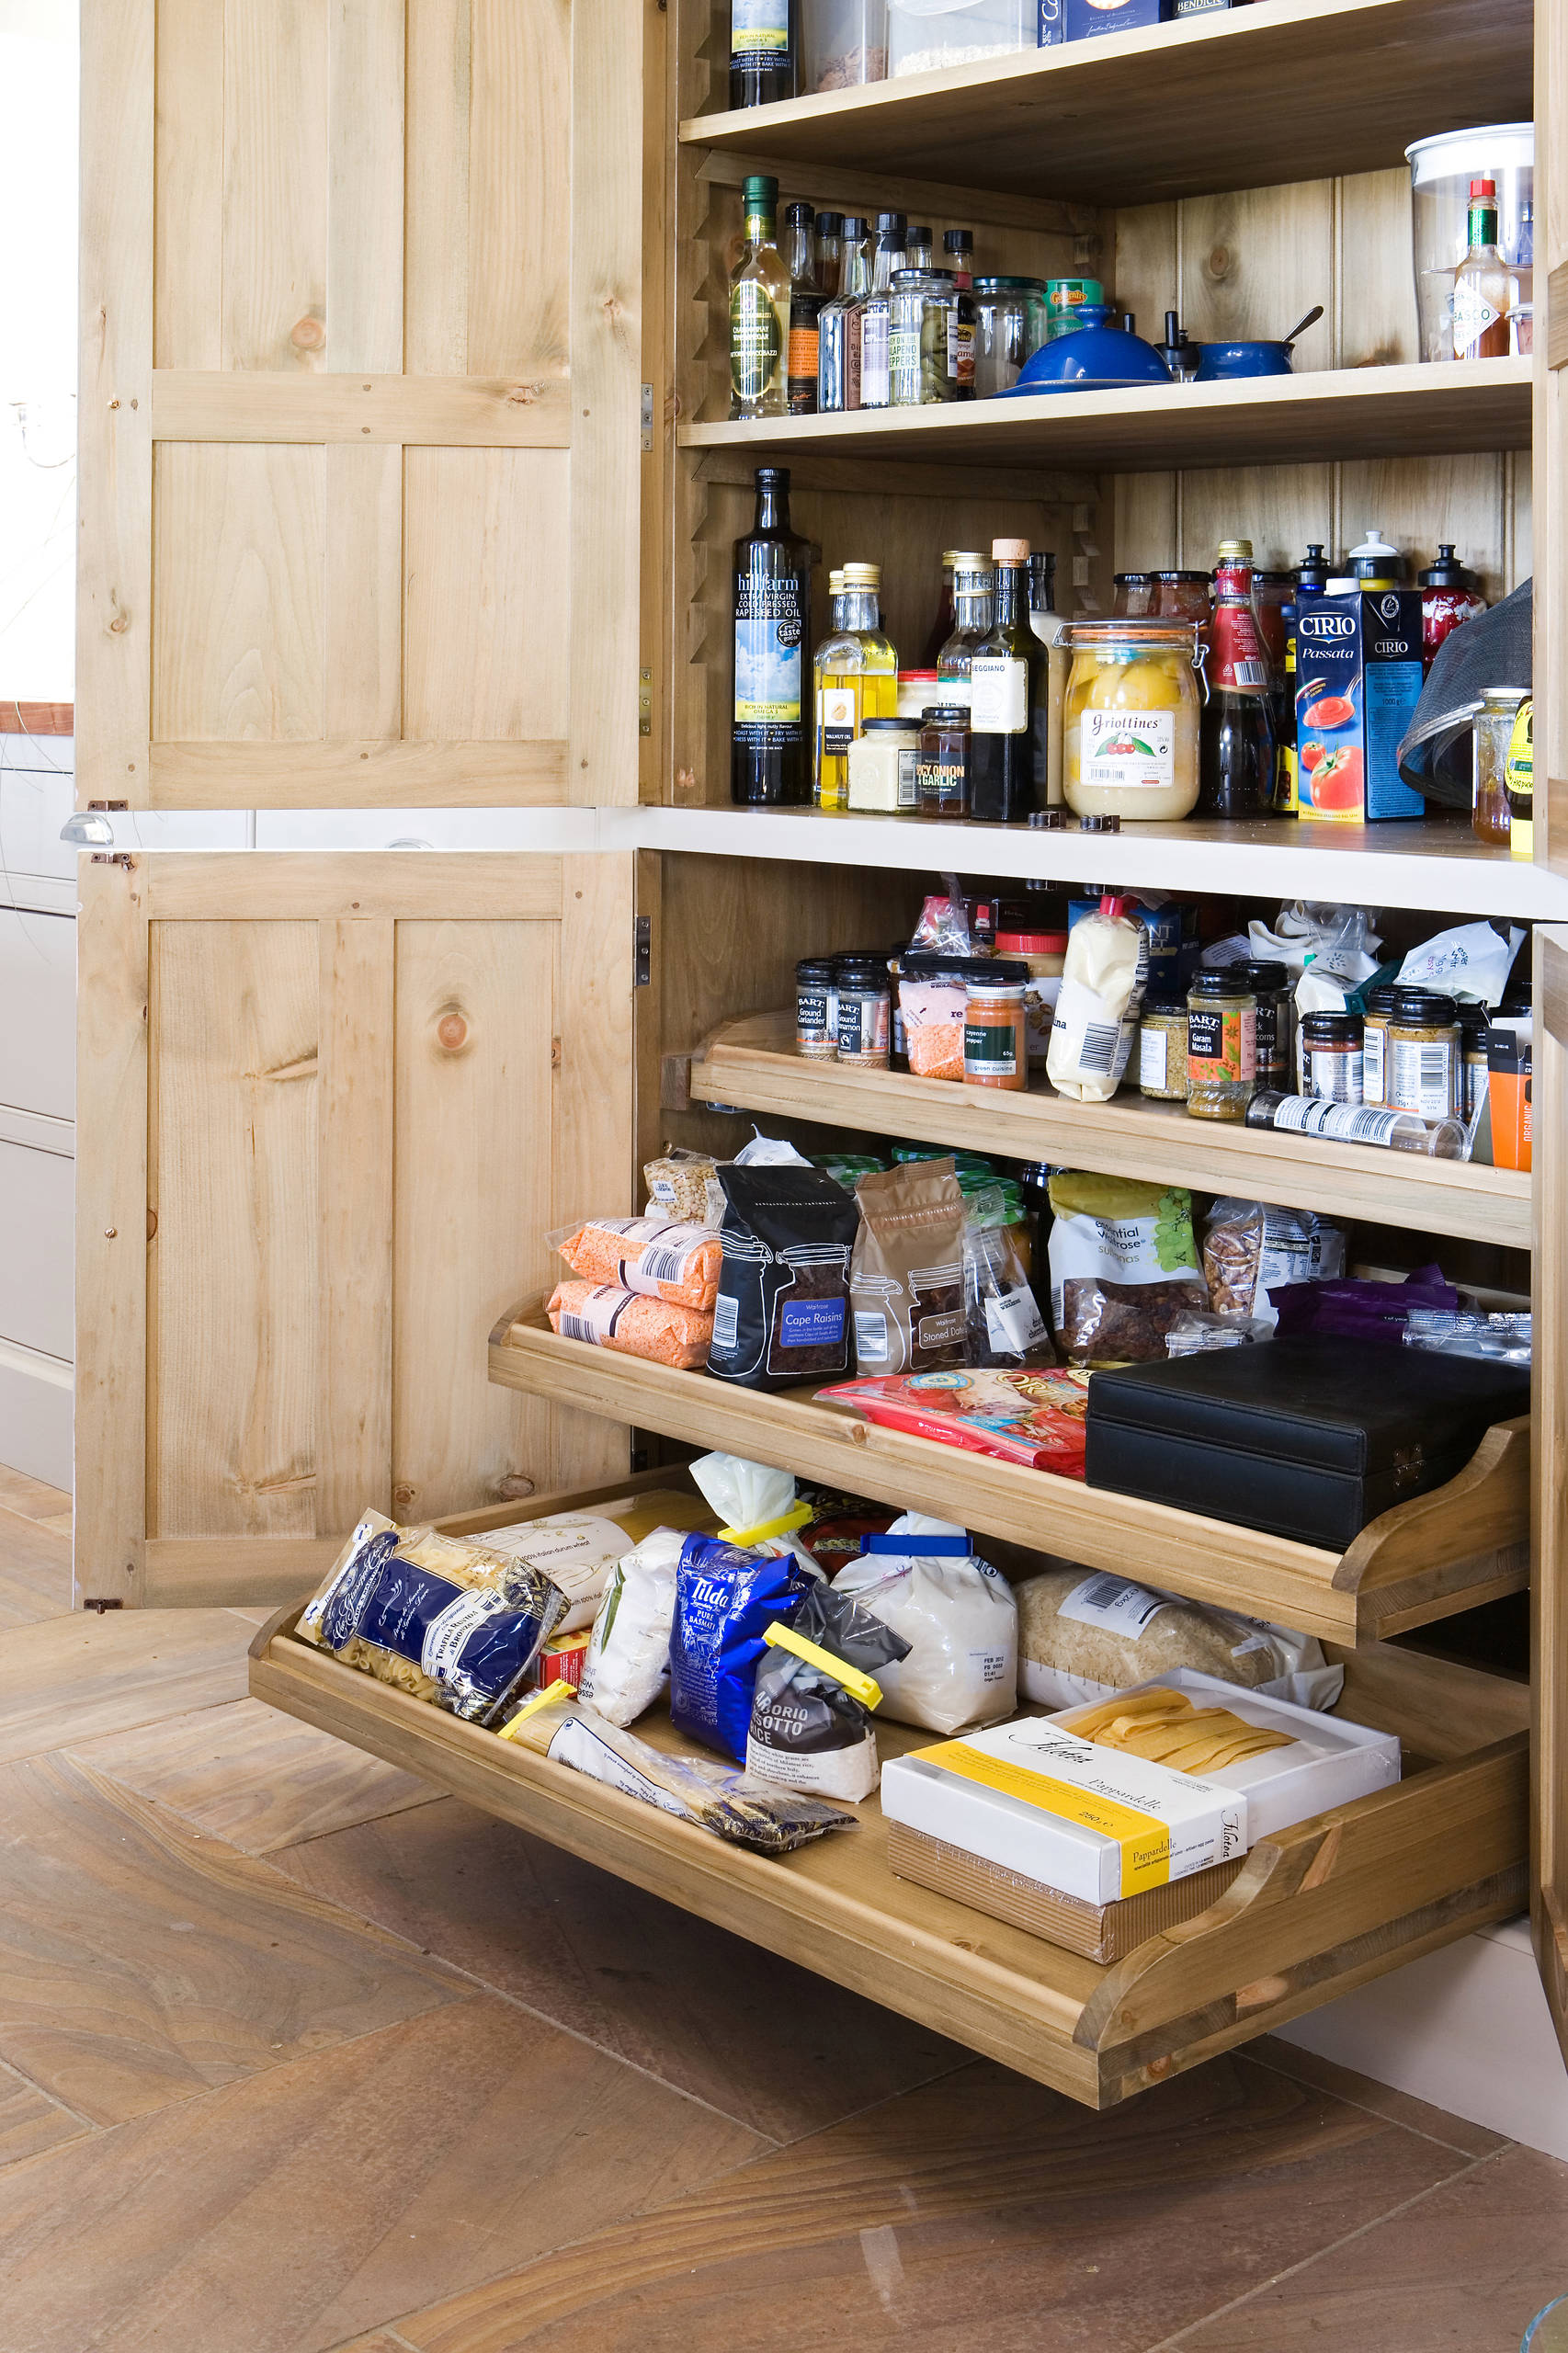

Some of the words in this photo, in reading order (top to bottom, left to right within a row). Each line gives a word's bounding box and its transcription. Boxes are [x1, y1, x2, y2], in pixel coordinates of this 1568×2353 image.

[738, 573, 799, 591] hillfarm
[735, 608, 781, 617] RAPESEED
[785, 608, 801, 617] OIL
[1299, 617, 1357, 636] CIRIO
[778, 629, 801, 637] taste
[1302, 648, 1354, 659] Passata
[1374, 642, 1408, 654] CIRIO
[933, 765, 964, 777] ONION
[922, 775, 957, 786] GARLIC
[799, 1008, 822, 1017] Ground
[1256, 1006, 1275, 1018] RT.
[798, 1015, 825, 1025] Coriander
[838, 1023, 860, 1031] namon
[1192, 1033, 1211, 1043] Garam
[1192, 1041, 1212, 1052] Masala
[1524, 1105, 1532, 1142] ORGANIC
[785, 1313, 811, 1326] Cape
[813, 1312, 843, 1324] Raisins
[936, 1317, 957, 1326] Waitrose
[924, 1330, 949, 1342] Stoned
[521, 1553, 537, 1562] 100%
[537, 1549, 553, 1559] italian
[555, 1544, 573, 1553] durum
[573, 1540, 591, 1549] wheat
[691, 1579, 730, 1608] Tilda
[697, 1609, 714, 1620] PURE
[689, 1616, 716, 1631] BASMATI
[436, 1629, 454, 1661] TRAFILA
[450, 1610, 479, 1629] RUVIDA
[756, 1690, 808, 1722] ARBORIO
[749, 1720, 772, 1745] RICE
[1088, 1779, 1162, 1811] Pappardelle
[1132, 1837, 1177, 1863] Pappardelle
